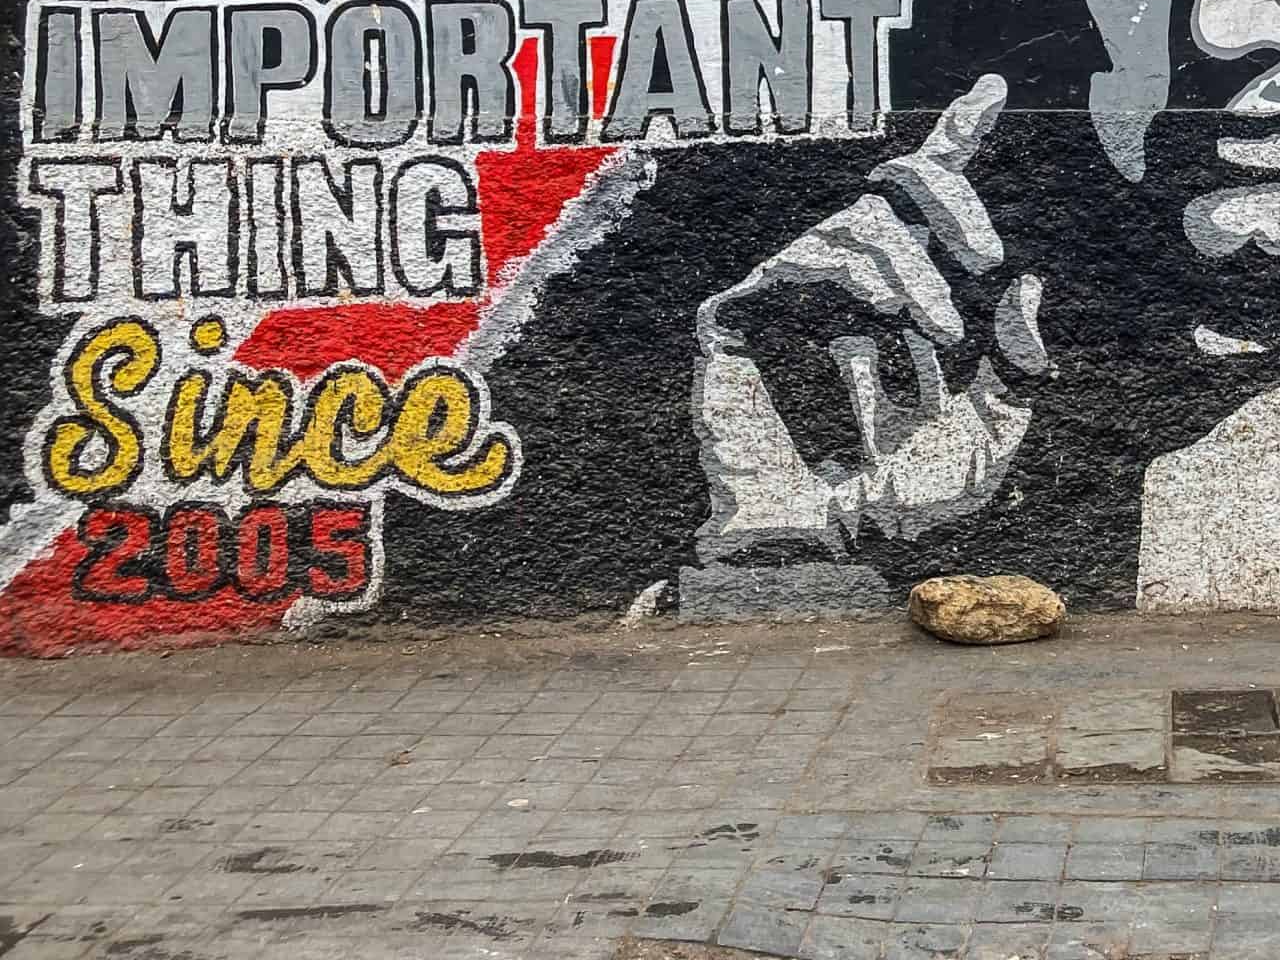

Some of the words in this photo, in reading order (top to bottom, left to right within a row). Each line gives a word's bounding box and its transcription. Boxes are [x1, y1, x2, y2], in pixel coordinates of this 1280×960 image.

[27, 154, 485, 302] THING
[42, 315, 514, 498] Since
[72, 501, 375, 605] 2005
